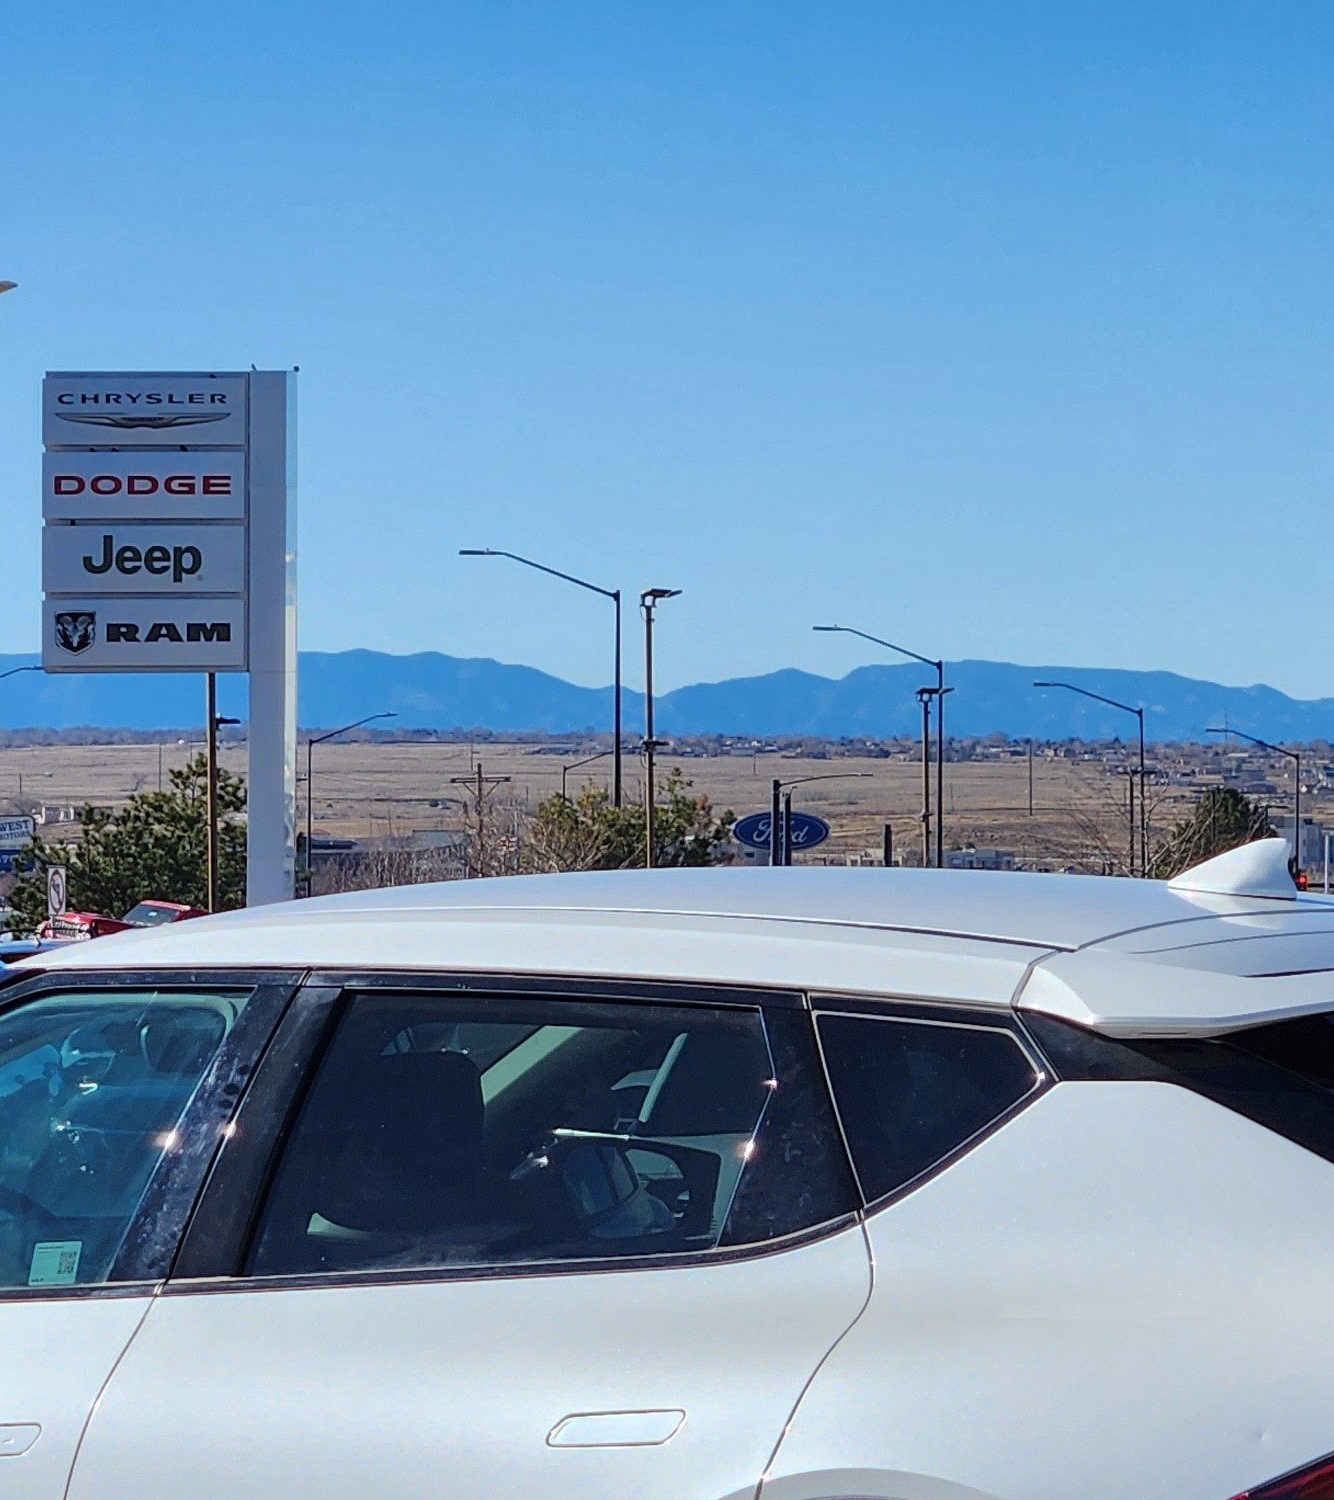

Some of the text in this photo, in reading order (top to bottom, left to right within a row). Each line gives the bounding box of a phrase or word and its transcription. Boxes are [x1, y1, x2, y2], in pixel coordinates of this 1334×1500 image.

[57, 393, 227, 405] CHRYSLER
[54, 475, 232, 496] DODGE
[82, 534, 203, 583] Jeep
[106, 622, 232, 643] RAM
